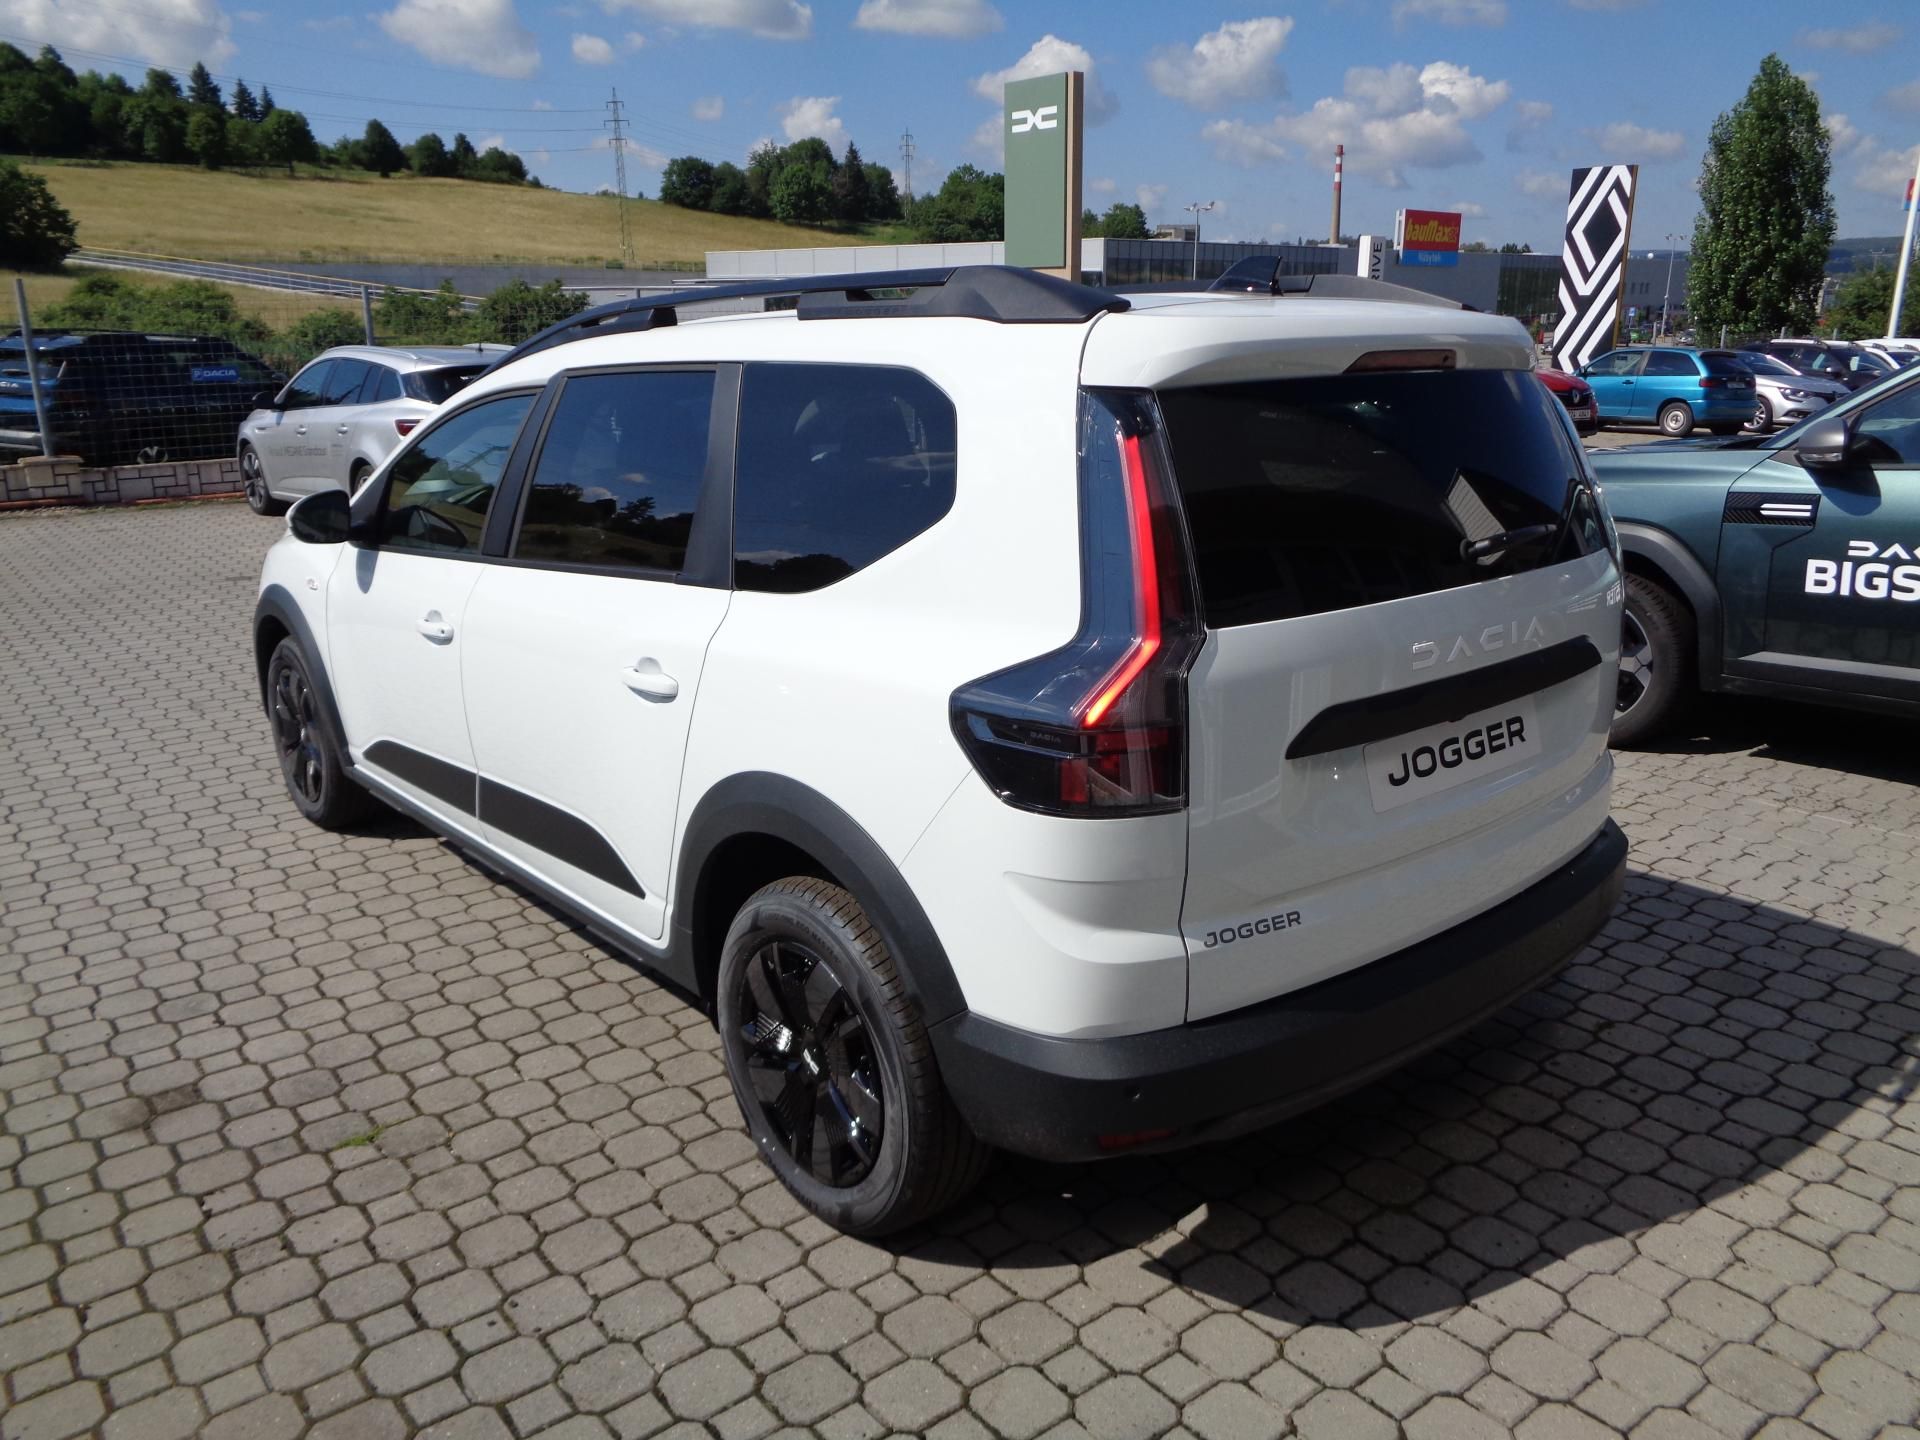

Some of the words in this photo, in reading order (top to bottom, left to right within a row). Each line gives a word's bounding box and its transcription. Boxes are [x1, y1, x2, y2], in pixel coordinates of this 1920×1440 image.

[1848, 540, 1920, 560] DA
[1805, 558, 1920, 602] BIGS
[1412, 616, 1544, 671] DACIA
[1388, 716, 1526, 786] JOGGER
[1203, 911, 1302, 948] JOGGER
